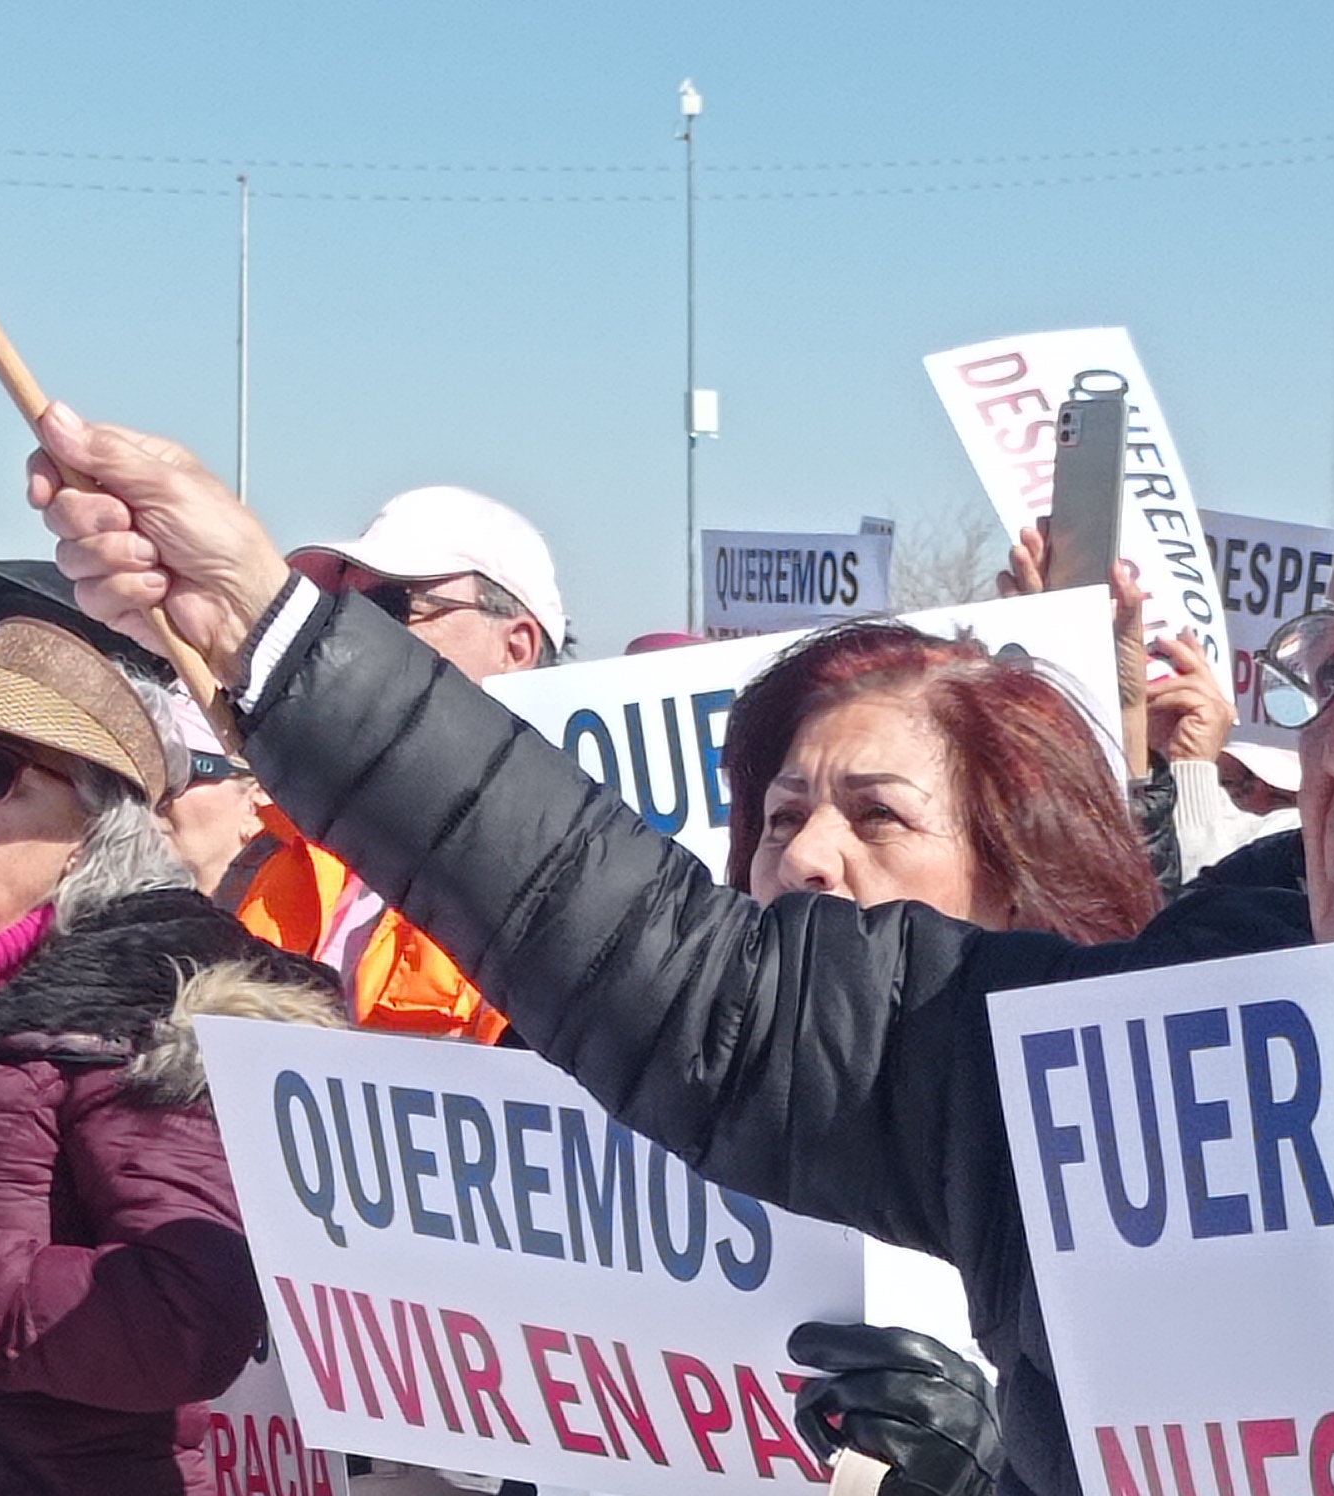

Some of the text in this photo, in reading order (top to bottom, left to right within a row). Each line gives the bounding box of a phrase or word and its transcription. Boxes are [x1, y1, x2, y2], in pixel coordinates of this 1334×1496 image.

[716, 547, 859, 611] QUEREMOS
[273, 1069, 772, 1292] QUEREMOS
[274, 1275, 530, 1446] VIVIR
[521, 1322, 670, 1467] EN
